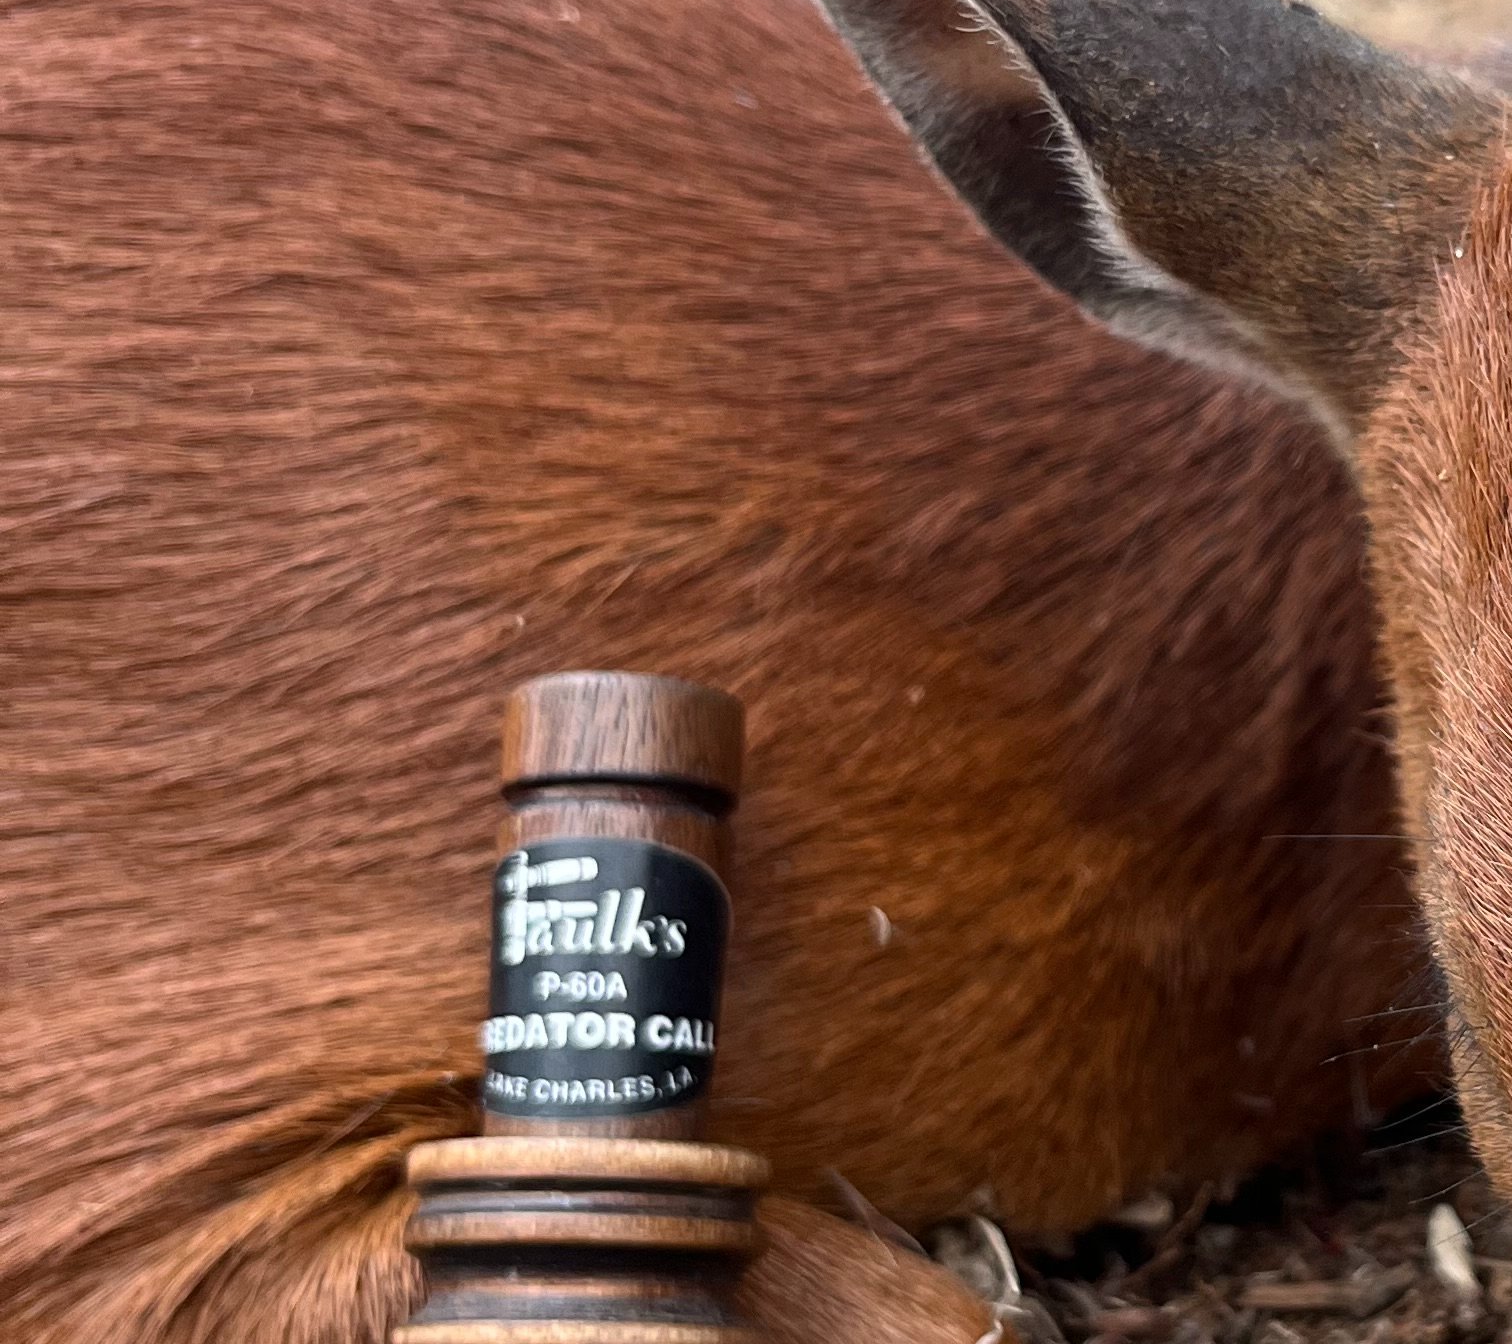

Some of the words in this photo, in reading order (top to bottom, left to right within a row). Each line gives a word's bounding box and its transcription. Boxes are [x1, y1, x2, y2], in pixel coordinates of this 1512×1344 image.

[502, 851, 687, 964] Faulk's
[534, 971, 628, 1001] P-60A
[530, 1075, 662, 1104] CHARLES,
